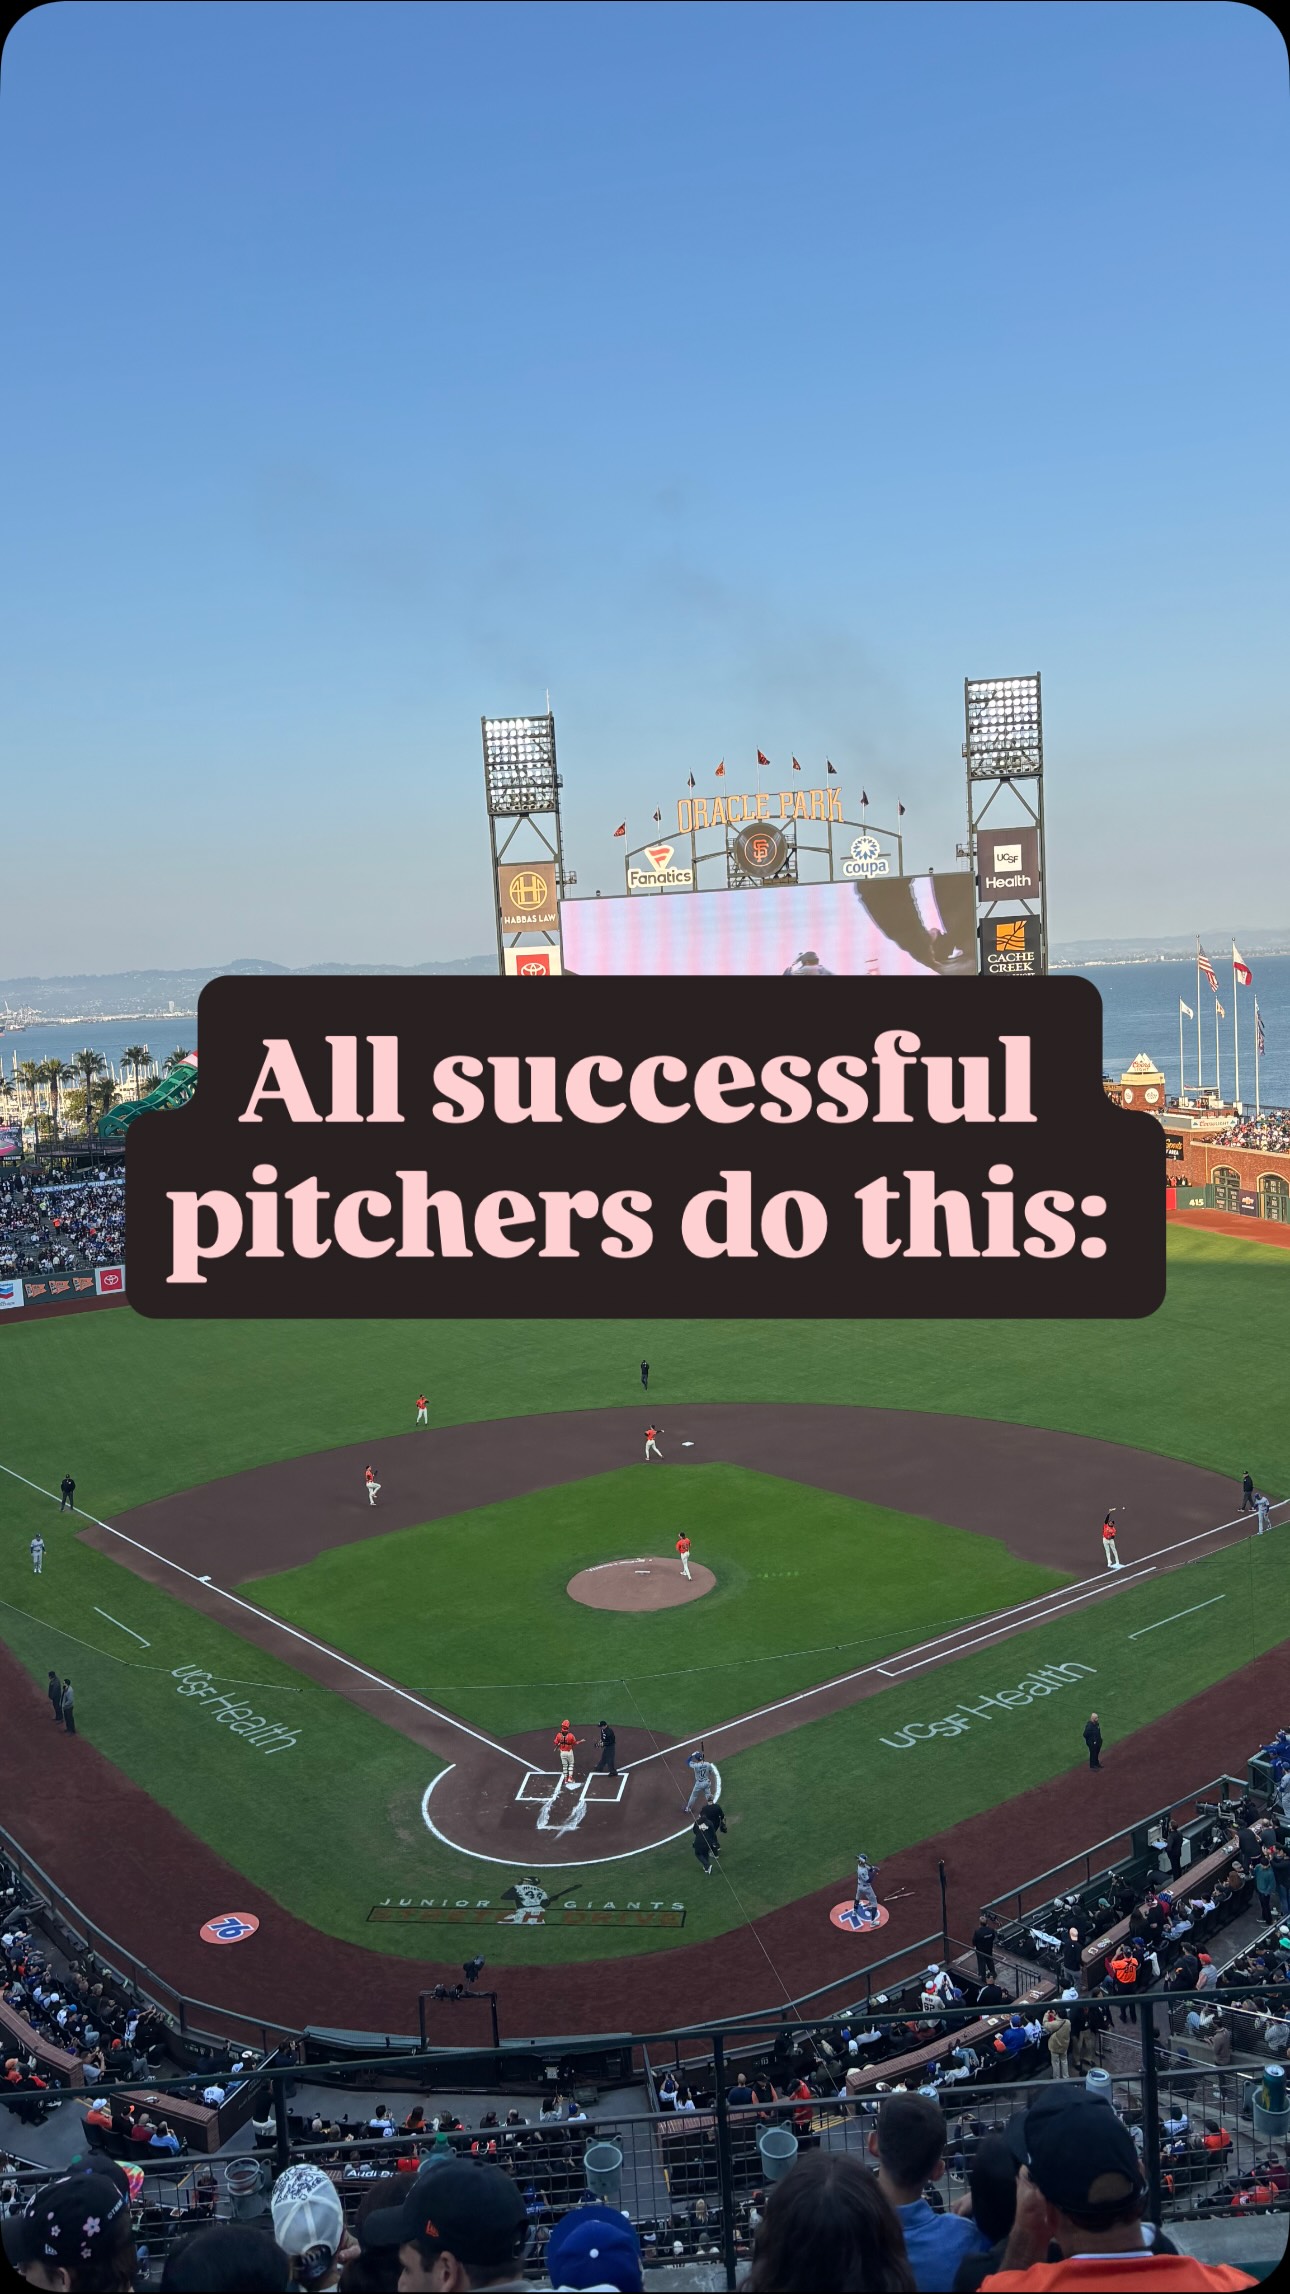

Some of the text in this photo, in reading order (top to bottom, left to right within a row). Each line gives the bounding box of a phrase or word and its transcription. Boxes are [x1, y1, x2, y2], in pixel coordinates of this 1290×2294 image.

[677, 787, 844, 834] ORACLE PARK
[996, 852, 1019, 864] UCSF
[845, 861, 887, 876] coupa
[630, 869, 692, 886] Fanatics
[985, 874, 1031, 889] Health
[504, 914, 556, 925] HABBAS LAW
[987, 951, 1035, 964] CACHE
[989, 962, 1034, 974] CREEK
[1188, 1198, 1204, 1207] 415
[171, 1664, 303, 1754] UCSF Health
[879, 1662, 1097, 1748] UCSF Health
[380, 1898, 685, 1911] JUNIOR GIANTS
[207, 1916, 255, 1940] 76
[346, 2169, 377, 2178] Audi
